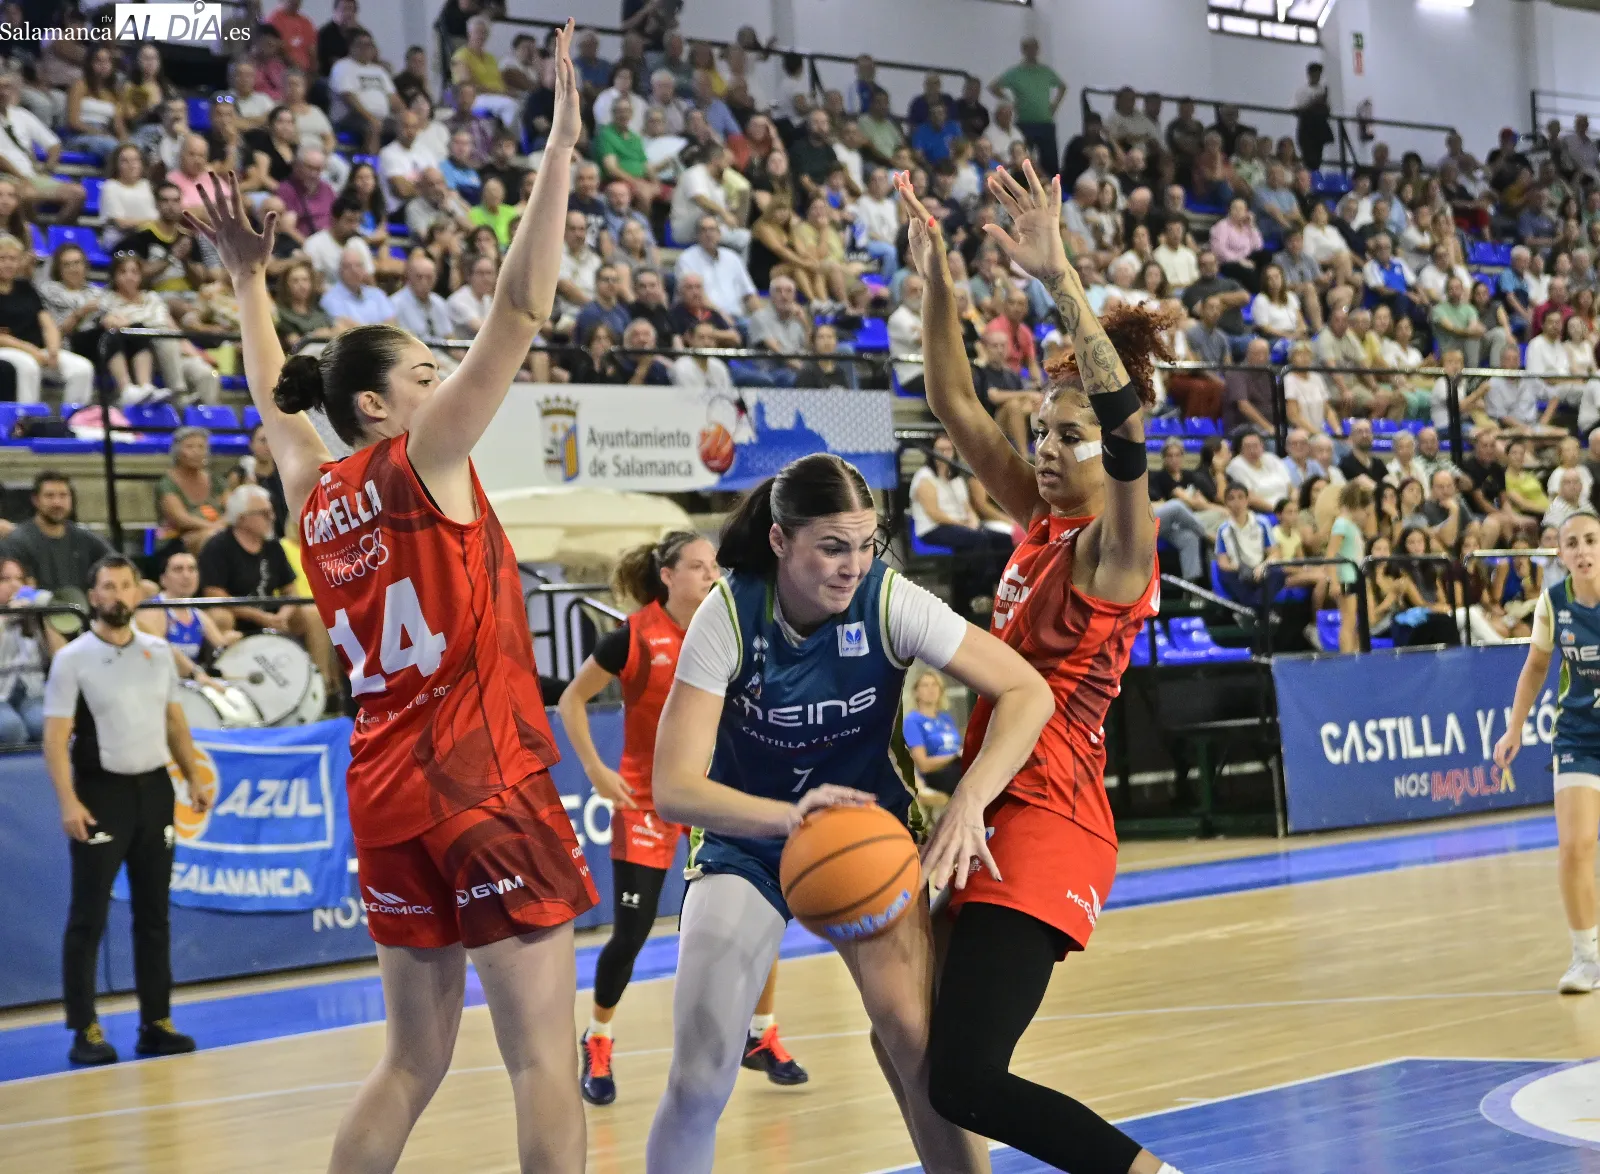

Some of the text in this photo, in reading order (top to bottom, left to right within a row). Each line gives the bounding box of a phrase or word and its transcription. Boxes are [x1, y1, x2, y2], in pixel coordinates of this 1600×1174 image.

[587, 427, 692, 453] Ayuntamiento
[588, 454, 693, 477] de Salamanca
[327, 577, 447, 698] 14
[742, 726, 807, 749] CASTILLA
[1320, 712, 1466, 765] CASTILLA
[1476, 709, 1495, 760] Y
[791, 767, 814, 793] 7
[1394, 772, 1430, 799] NOS
[215, 778, 323, 818] AZUL
